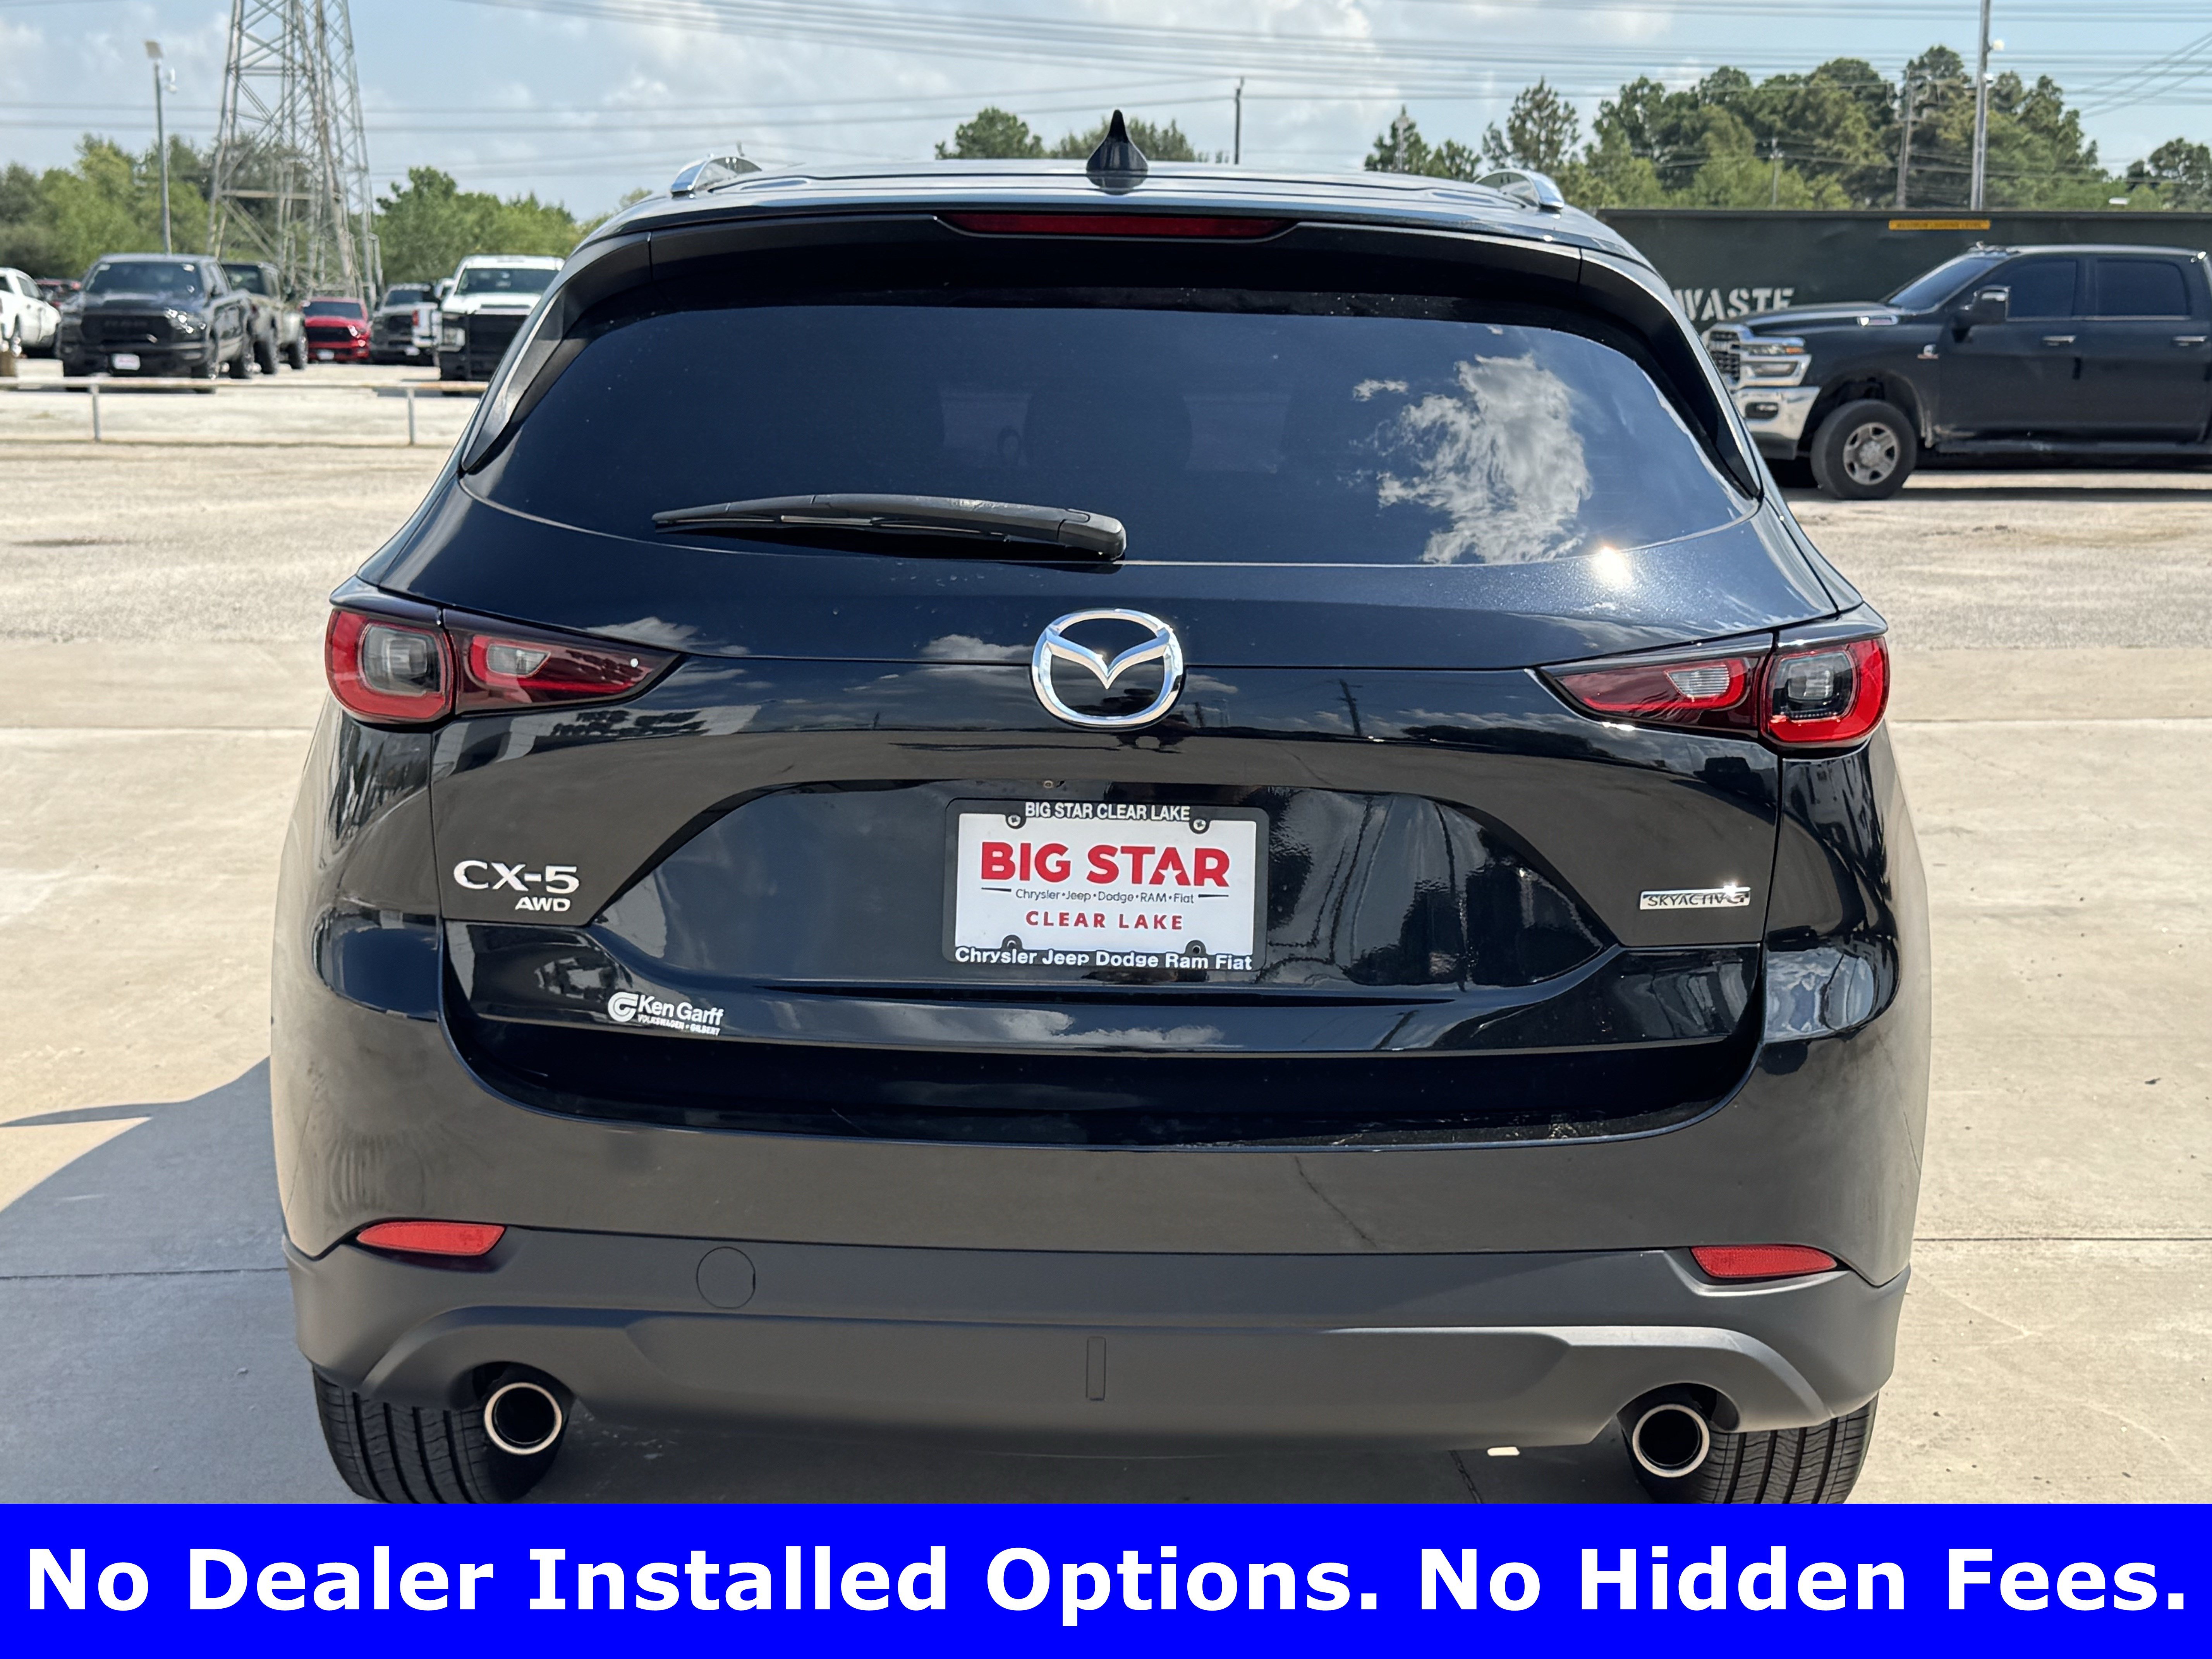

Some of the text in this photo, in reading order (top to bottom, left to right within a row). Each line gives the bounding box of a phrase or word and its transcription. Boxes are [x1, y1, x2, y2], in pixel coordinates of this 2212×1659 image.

[1673, 287, 1795, 321] WASTE
[1025, 802, 1190, 822] BIG STAR CLEAR LAKE
[981, 842, 1230, 887] BIG STAR
[453, 860, 580, 894] CX-5
[515, 896, 571, 912] AWD
[1015, 889, 1194, 903] Chrysler Jeep Dodge RAM Fiat
[1025, 910, 1182, 930] CLEAR LAKE
[955, 947, 1252, 971] Chrysler Jeep Dodge Ram Fiat
[639, 994, 724, 1025] Ken Garff
